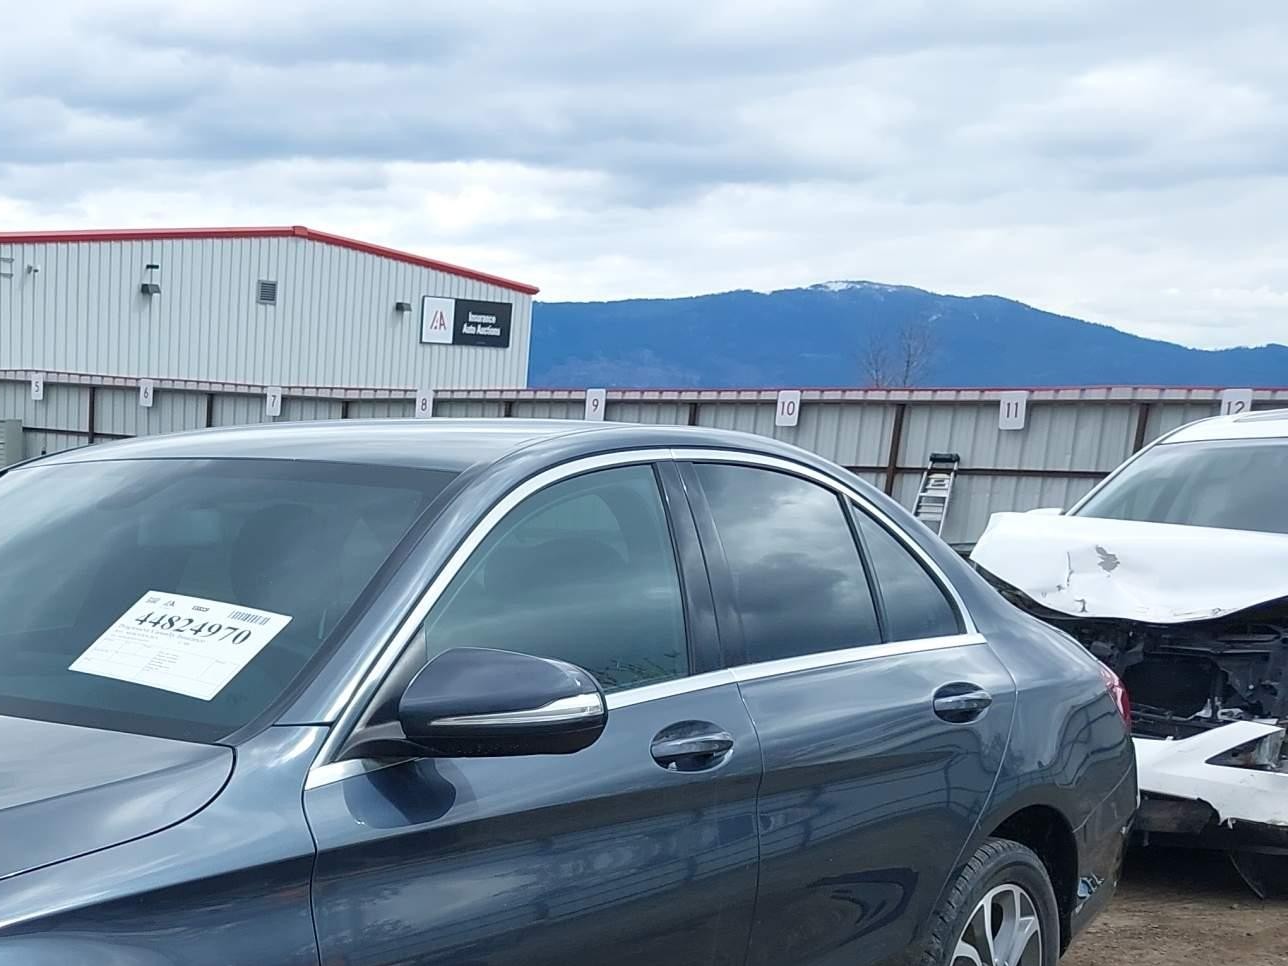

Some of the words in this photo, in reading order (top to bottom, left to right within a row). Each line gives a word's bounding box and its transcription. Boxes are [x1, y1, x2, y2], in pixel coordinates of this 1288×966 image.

[468, 311, 496, 324] Insurance
[462, 322, 476, 335] Auto
[476, 323, 501, 336] Auctions
[34, 380, 40, 393] 5
[143, 386, 149, 399] 6
[271, 394, 277, 408] 7
[420, 398, 428, 412] 8
[592, 398, 599, 412] 9
[781, 400, 796, 416] 10
[1226, 400, 1246, 416] 12
[1006, 401, 1019, 419] 11
[134, 611, 252, 645] 44824970
